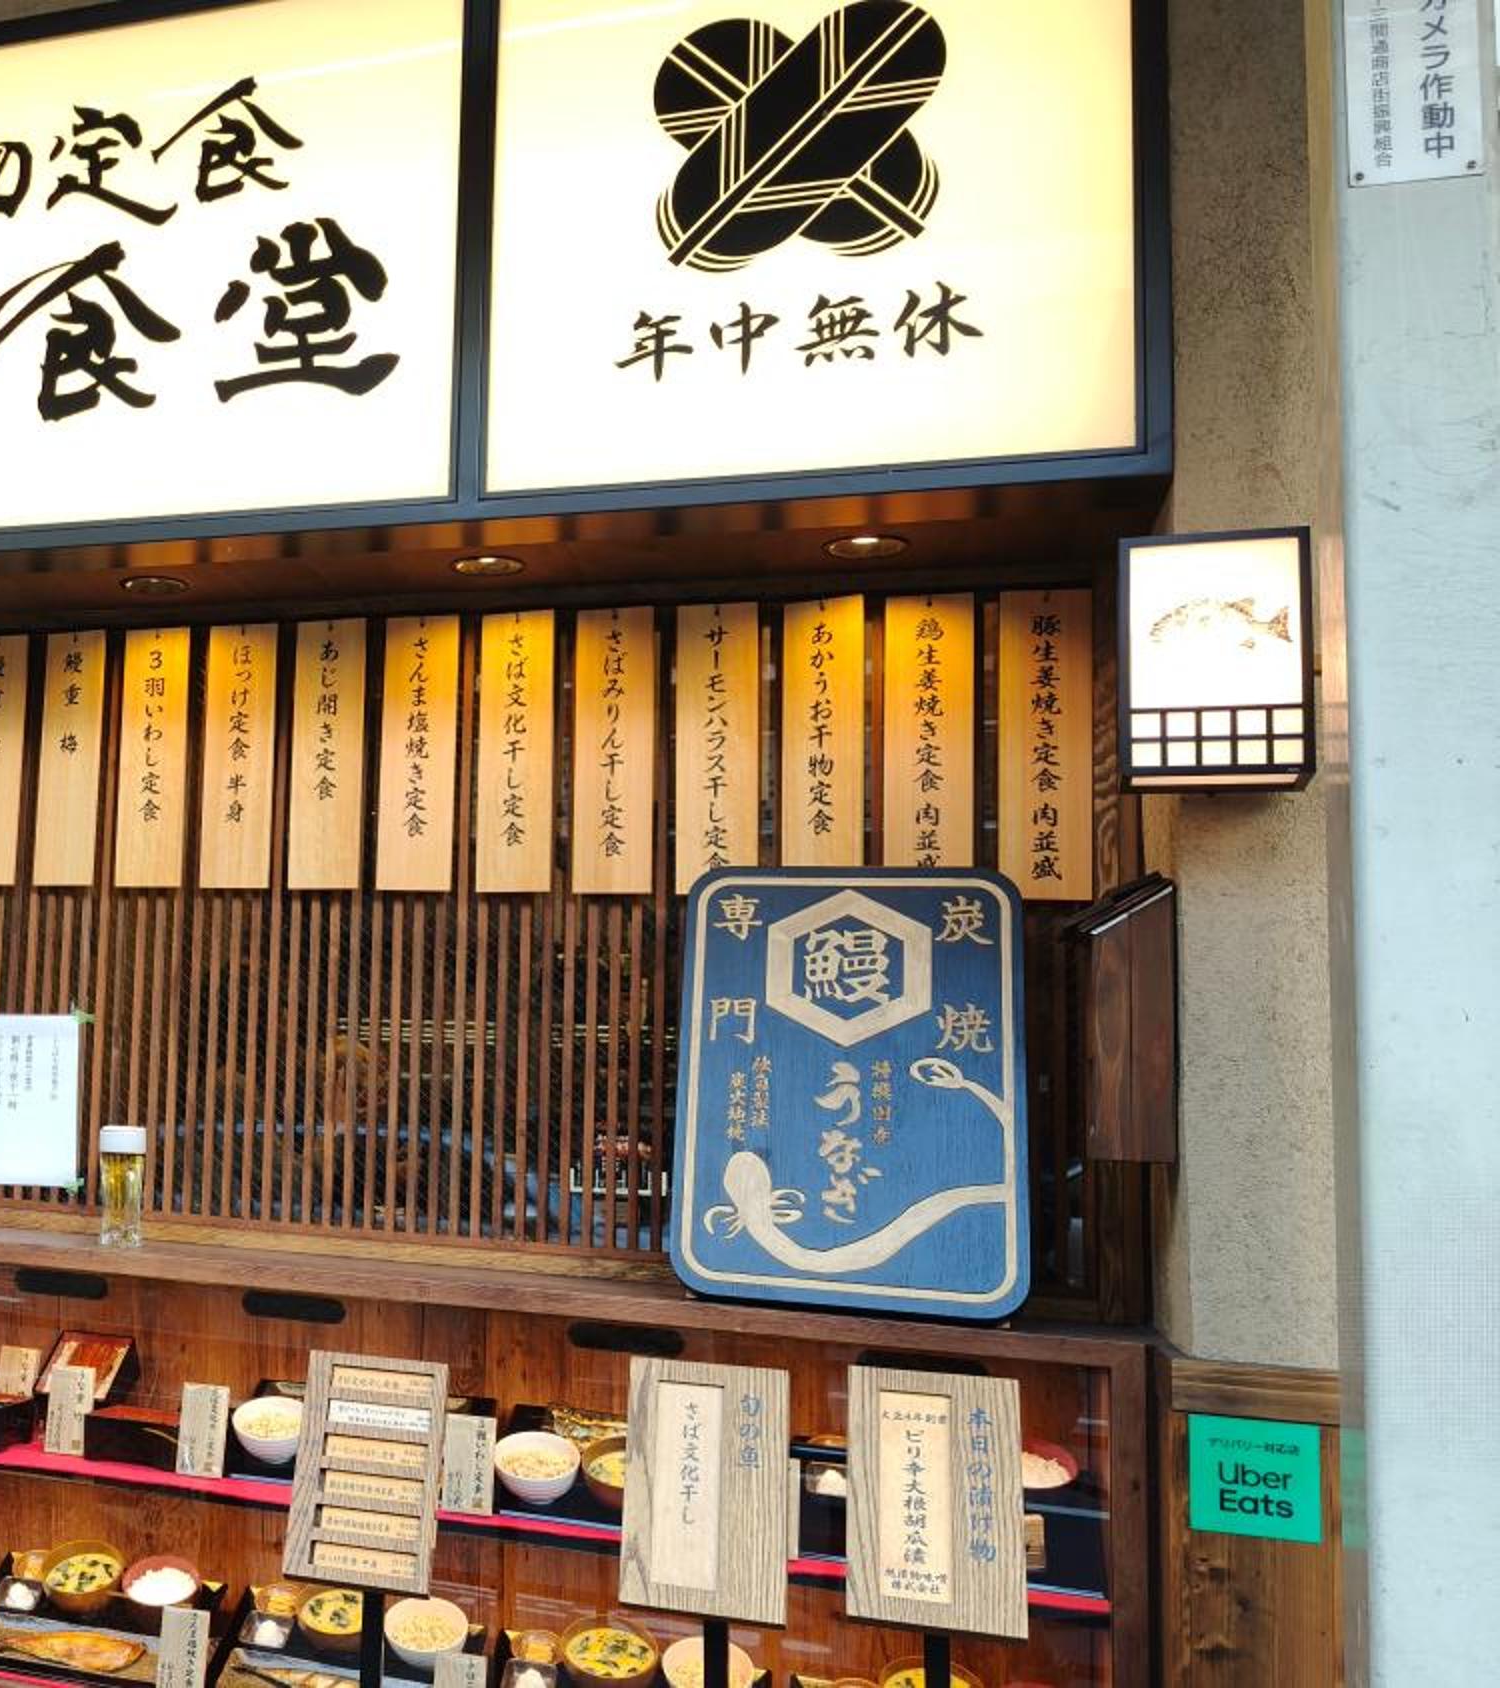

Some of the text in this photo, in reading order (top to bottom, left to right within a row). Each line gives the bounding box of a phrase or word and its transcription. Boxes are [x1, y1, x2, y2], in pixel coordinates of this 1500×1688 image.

[612, 280, 985, 383] 年中無休
[225, 646, 254, 825] ほっけ定食 半身
[312, 639, 341, 802] あじ開き定食
[403, 635, 430, 838] さんま塩焼き定食
[502, 632, 527, 848] さば文化干し定食
[599, 628, 628, 858] さばみりん干し定食
[702, 624, 732, 872] サーモンハラス干し定食
[806, 620, 835, 836] あかうお干物定食
[913, 618, 945, 794] 鶏生姜焼き定食
[1030, 614, 1064, 881] 豚生姜焼き定食 肉並盛
[803, 928, 890, 1002] 鰻
[813, 1061, 883, 1224] うなぎ
[680, 1402, 700, 1526] さば文化干し
[739, 1395, 760, 1469] 旬の魚
[1218, 1460, 1293, 1490] Uber
[1219, 1488, 1295, 1519] Eats
